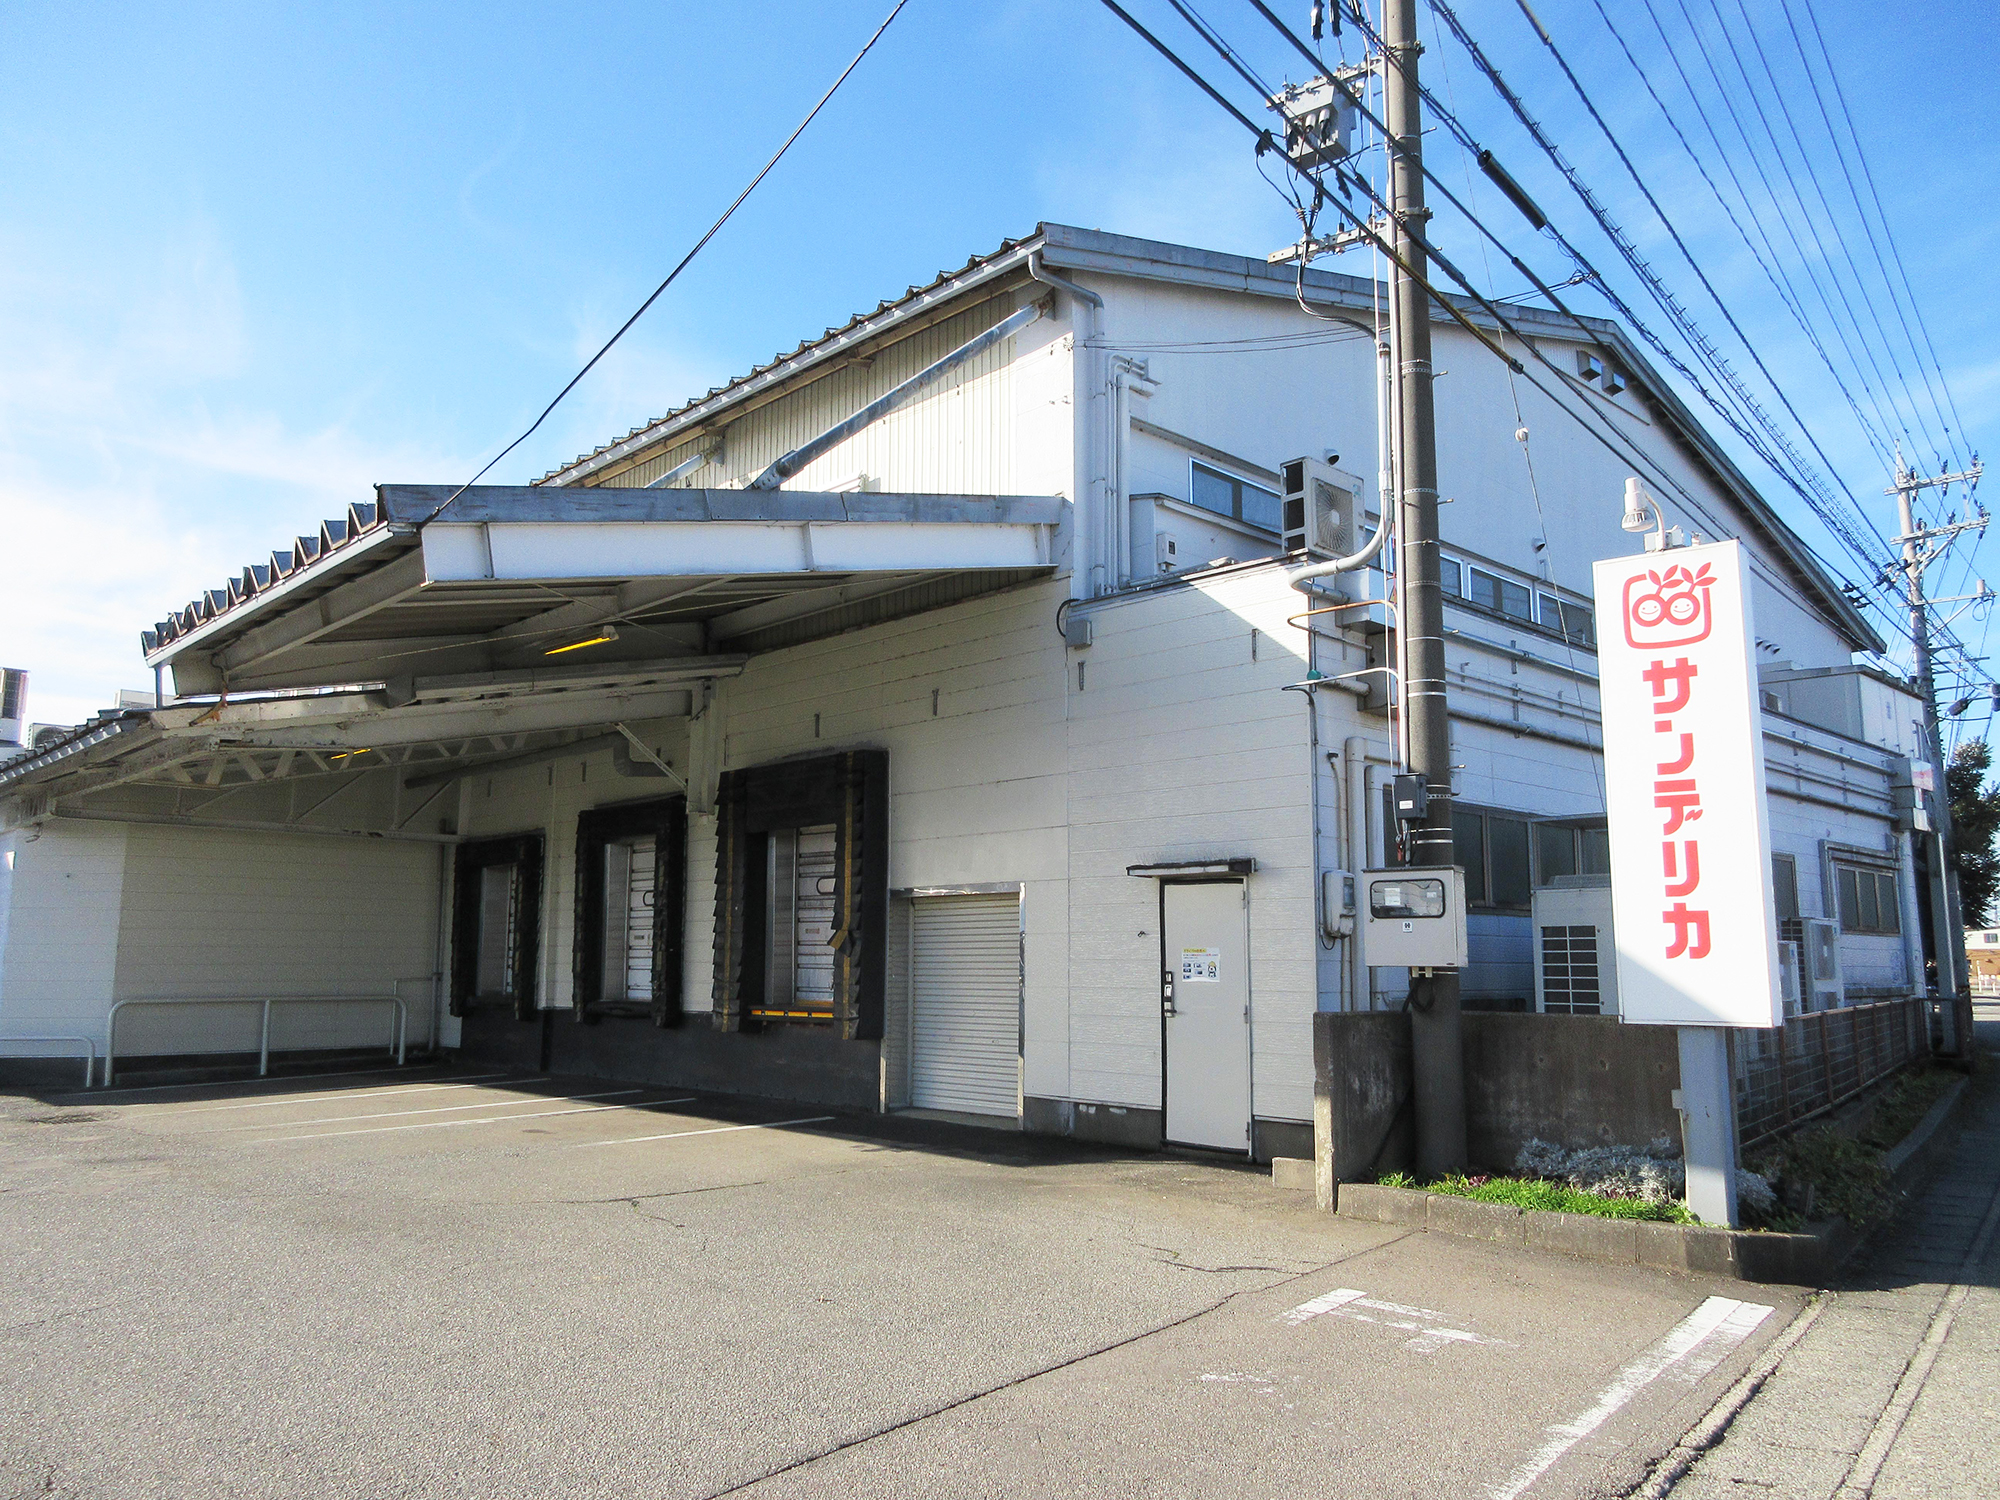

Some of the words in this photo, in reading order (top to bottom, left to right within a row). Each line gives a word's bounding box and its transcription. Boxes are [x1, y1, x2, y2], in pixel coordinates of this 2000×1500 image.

[1642, 657, 1711, 960] サンデリカ
